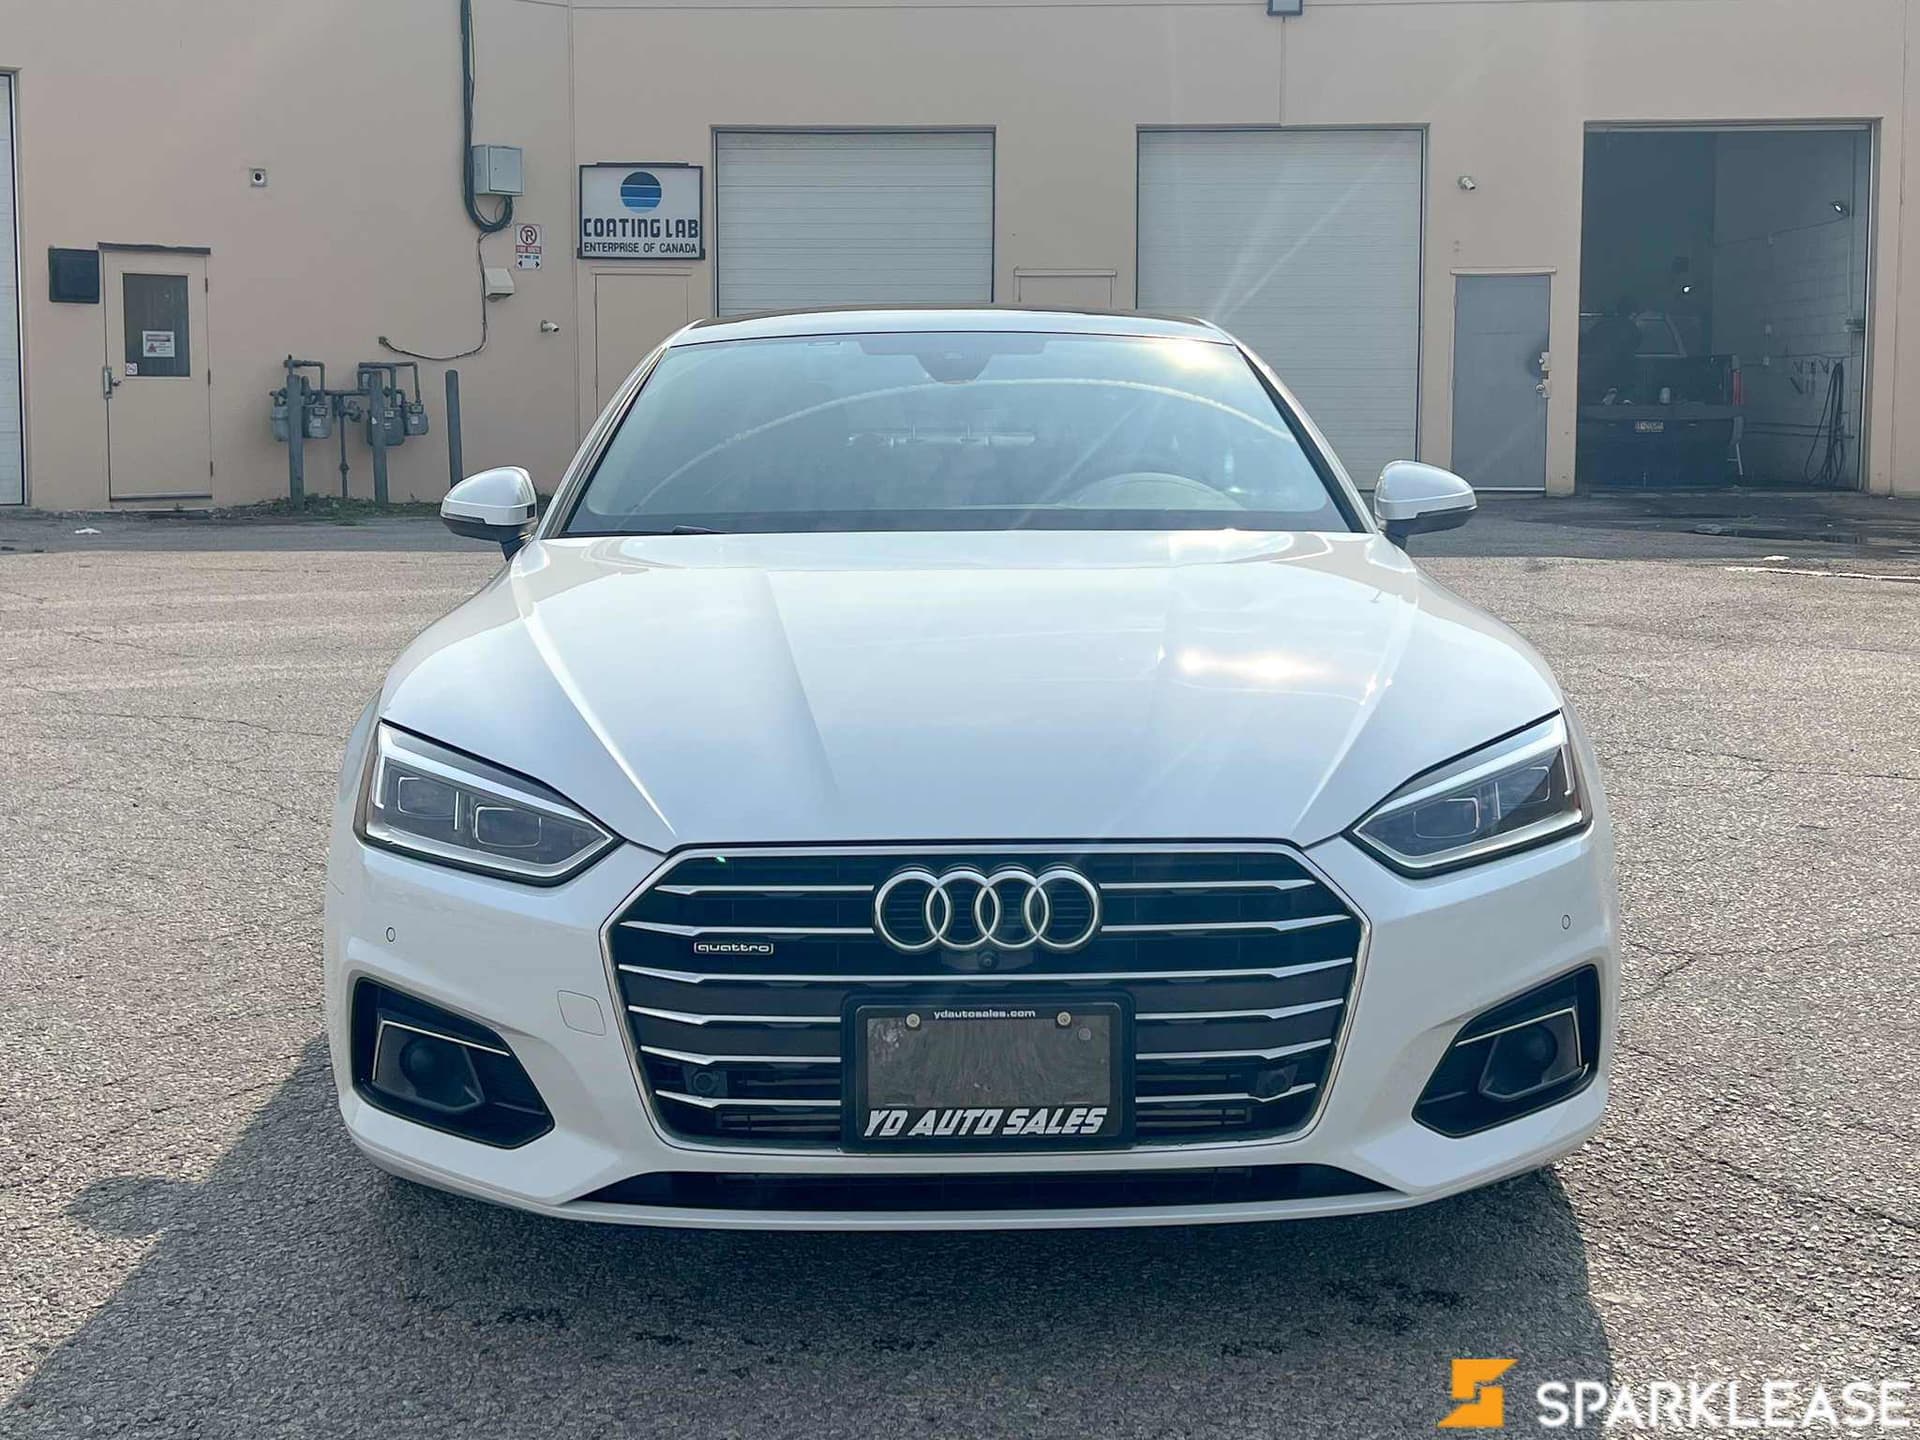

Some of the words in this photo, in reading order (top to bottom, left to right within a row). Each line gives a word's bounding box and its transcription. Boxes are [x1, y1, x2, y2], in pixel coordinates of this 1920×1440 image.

[584, 242, 640, 253] ENTERPRISE
[643, 242, 656, 253] OF
[659, 242, 697, 254] CANADA
[698, 944, 769, 953] quattro
[933, 1009, 1036, 1020] ydautosales.com
[864, 1109, 909, 1137] YD
[907, 1108, 1003, 1136] AUTO
[1001, 1107, 1108, 1135] SALES
